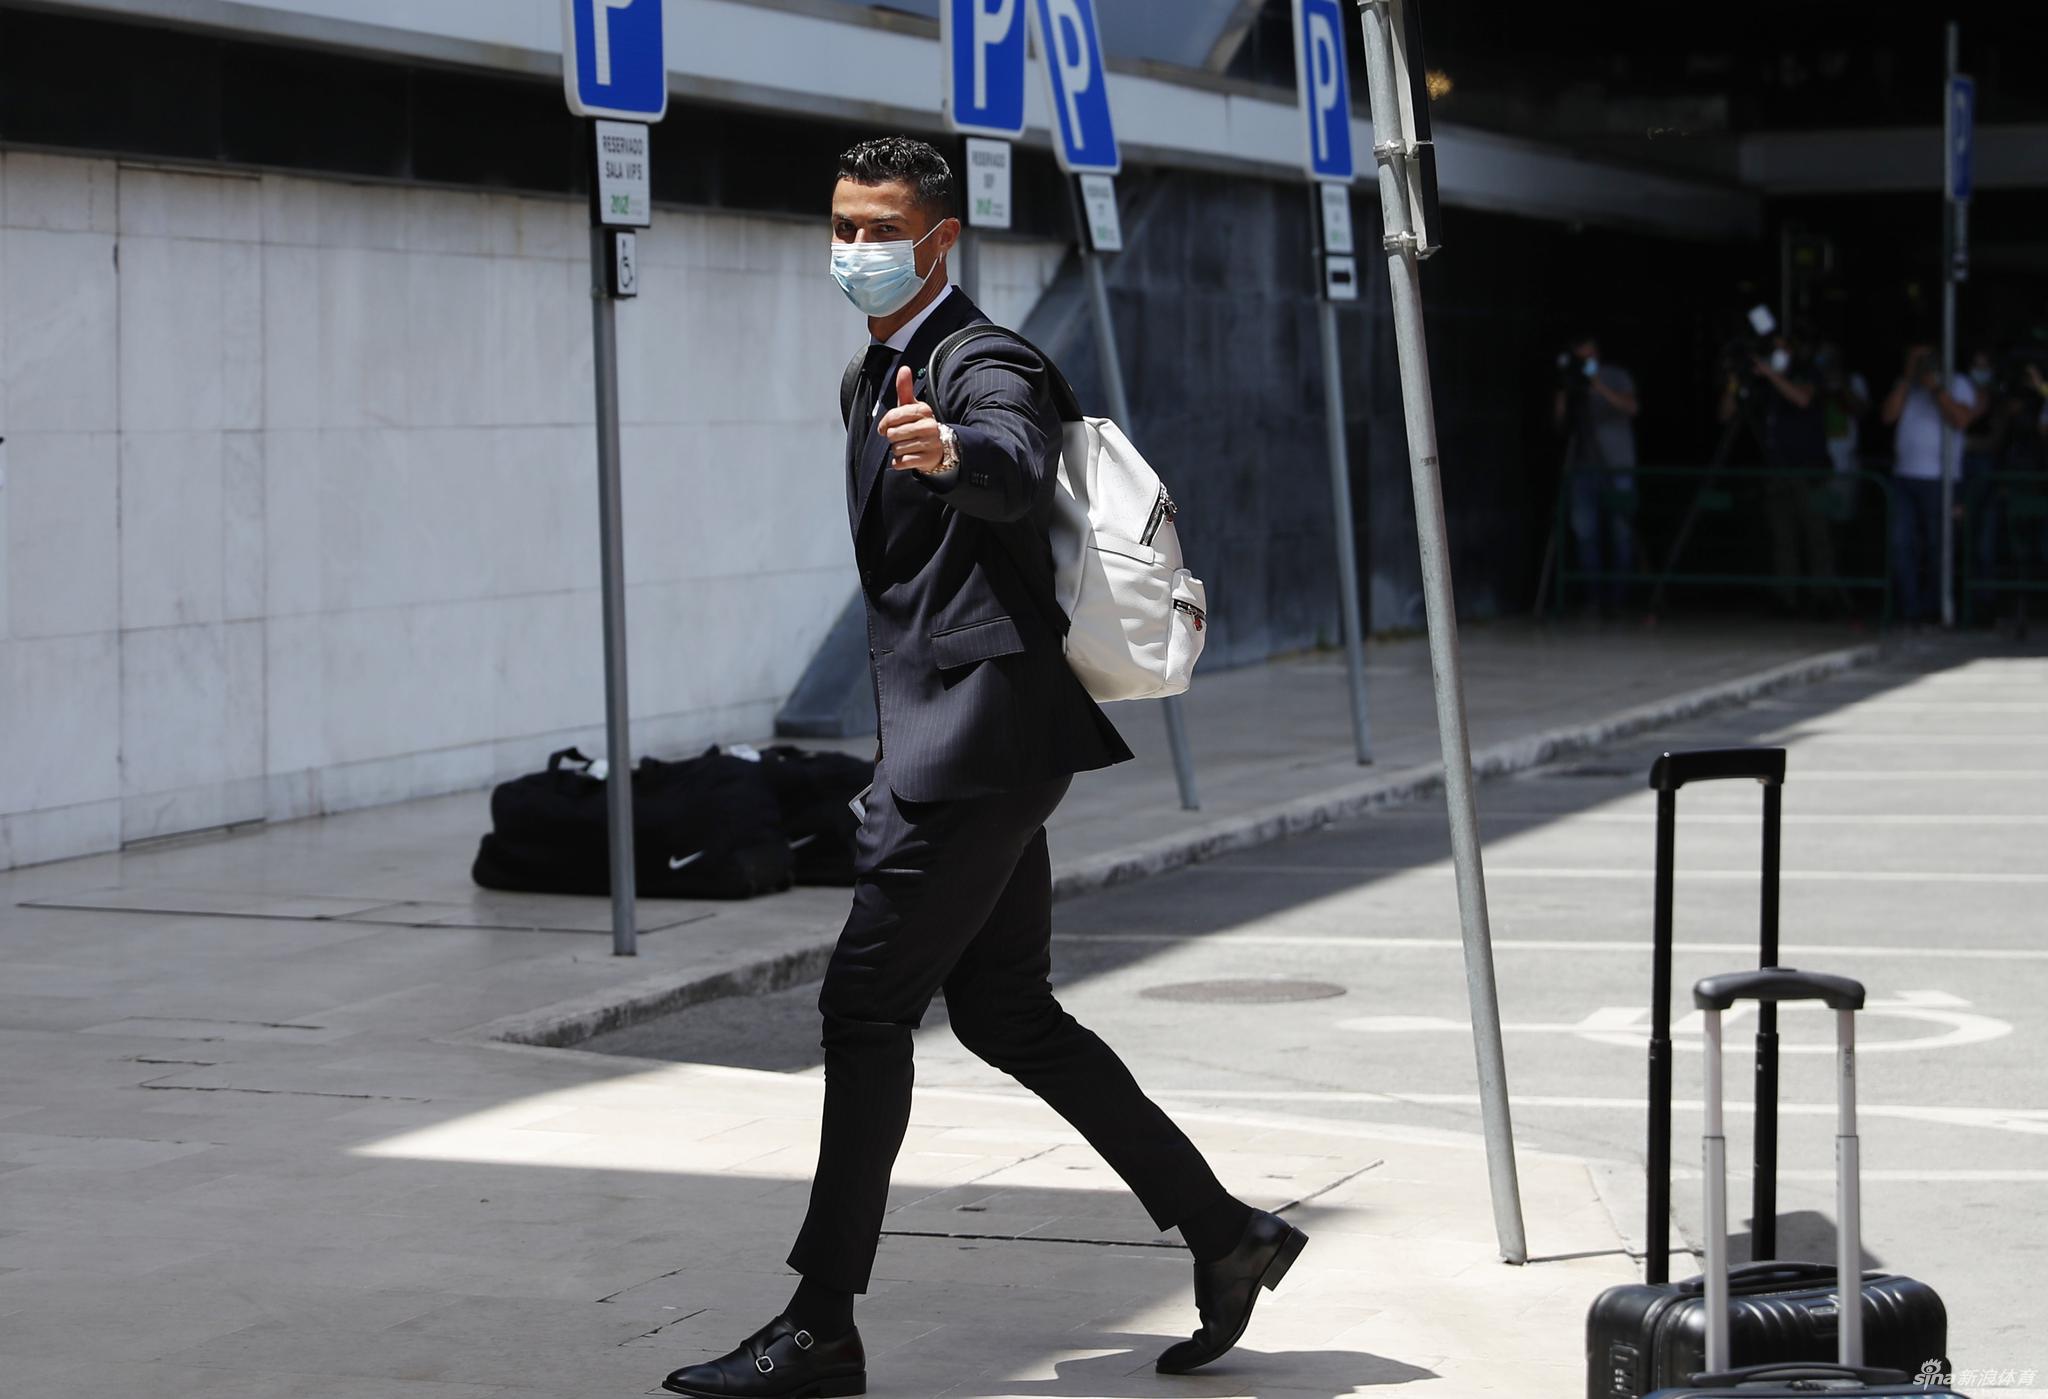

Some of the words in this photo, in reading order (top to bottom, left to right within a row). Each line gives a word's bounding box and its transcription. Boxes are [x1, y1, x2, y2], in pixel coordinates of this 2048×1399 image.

[973, 0, 1017, 109] P
[1046, 0, 1090, 150] P
[1309, 12, 1339, 161] P
